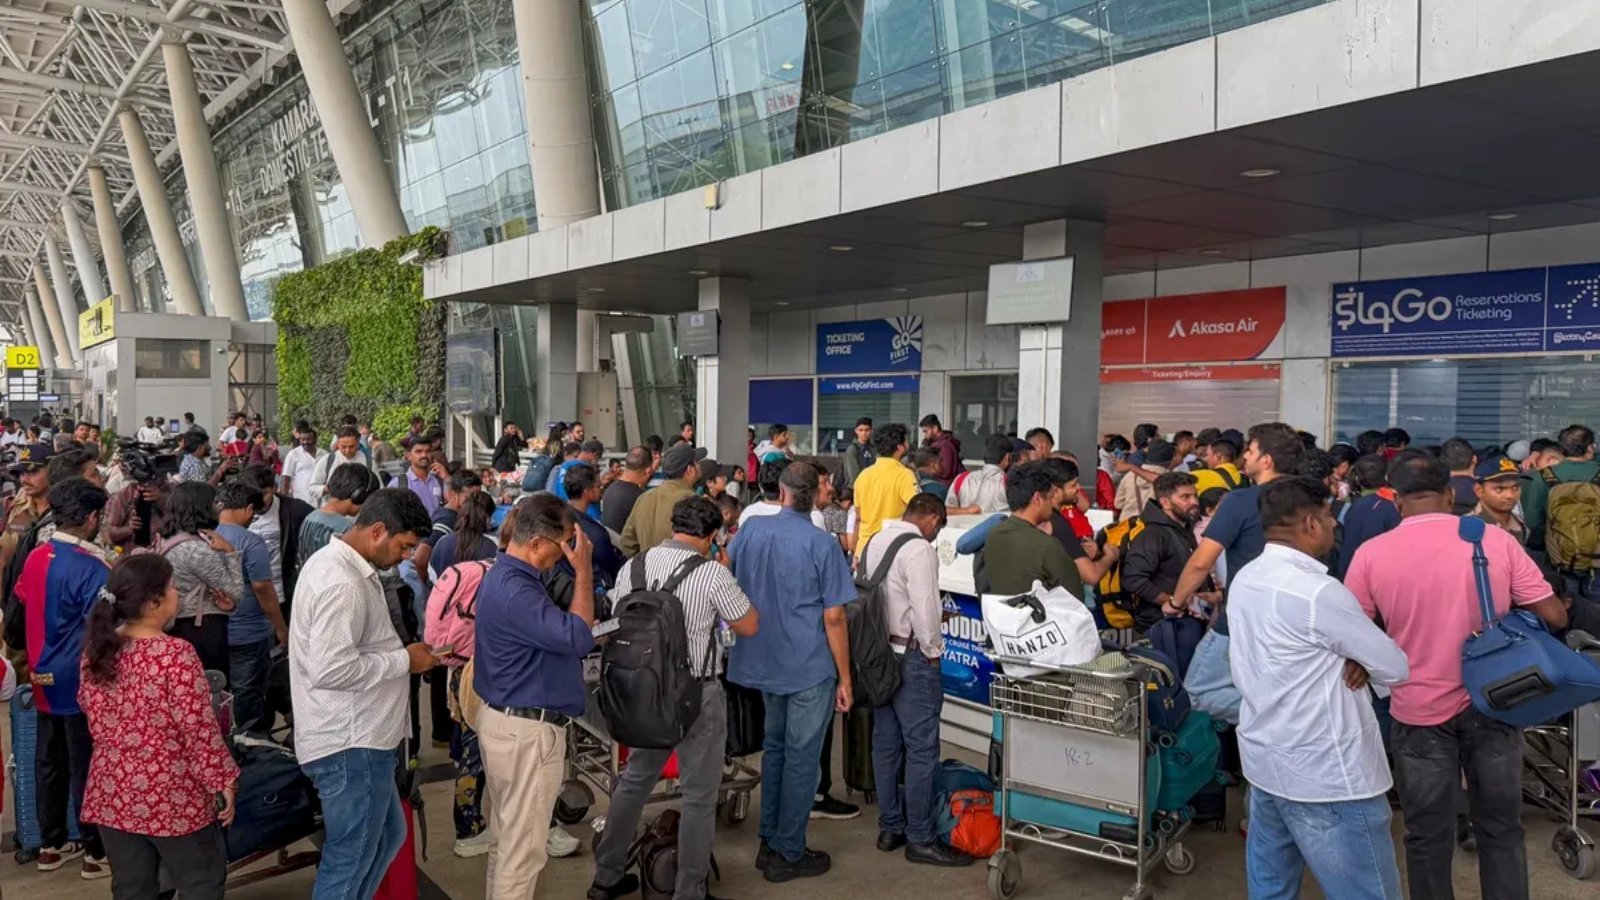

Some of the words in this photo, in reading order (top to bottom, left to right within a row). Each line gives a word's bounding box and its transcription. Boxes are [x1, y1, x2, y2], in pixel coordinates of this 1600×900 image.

[259, 137, 311, 195] DOMESTIC
[1455, 291, 1542, 307] Reservations
[1455, 308, 1513, 321] Ticketing
[1190, 321, 1234, 336] Akasa
[1236, 317, 1259, 332] Air
[826, 332, 865, 344] TICKETING
[892, 331, 911, 350] GO
[825, 345, 852, 356] OFFICE
[890, 347, 910, 360] FIRST
[16, 353, 35, 365] D2
[1152, 369, 1212, 379] Ticketing/Enquiry
[836, 381, 895, 391] www.FlyGoFirst.com
[948, 639, 970, 650] CRUISE
[1006, 630, 1059, 655] HANZO
[944, 649, 979, 669] YATRA
